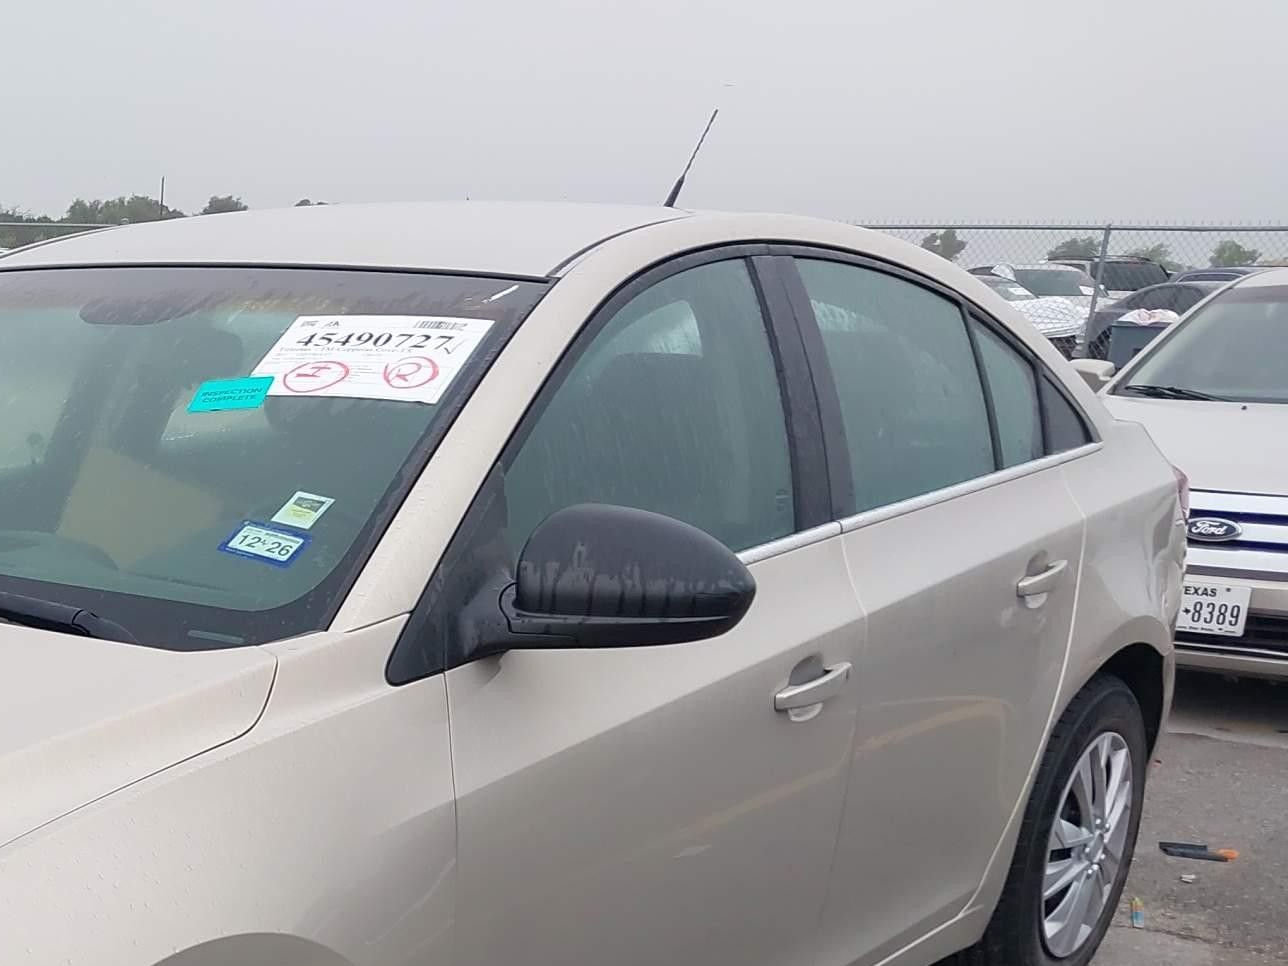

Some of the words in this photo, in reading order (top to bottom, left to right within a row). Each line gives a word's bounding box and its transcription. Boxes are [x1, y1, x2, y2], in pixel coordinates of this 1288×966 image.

[296, 331, 454, 349] 45490727
[201, 388, 263, 397] INSPECTION
[202, 395, 256, 403] COMPLETE
[1192, 521, 1226, 535] Ford
[238, 535, 261, 548] 12
[266, 542, 292, 556] 26
[1183, 586, 1217, 597] EXAS
[1192, 601, 1241, 626] 8389
